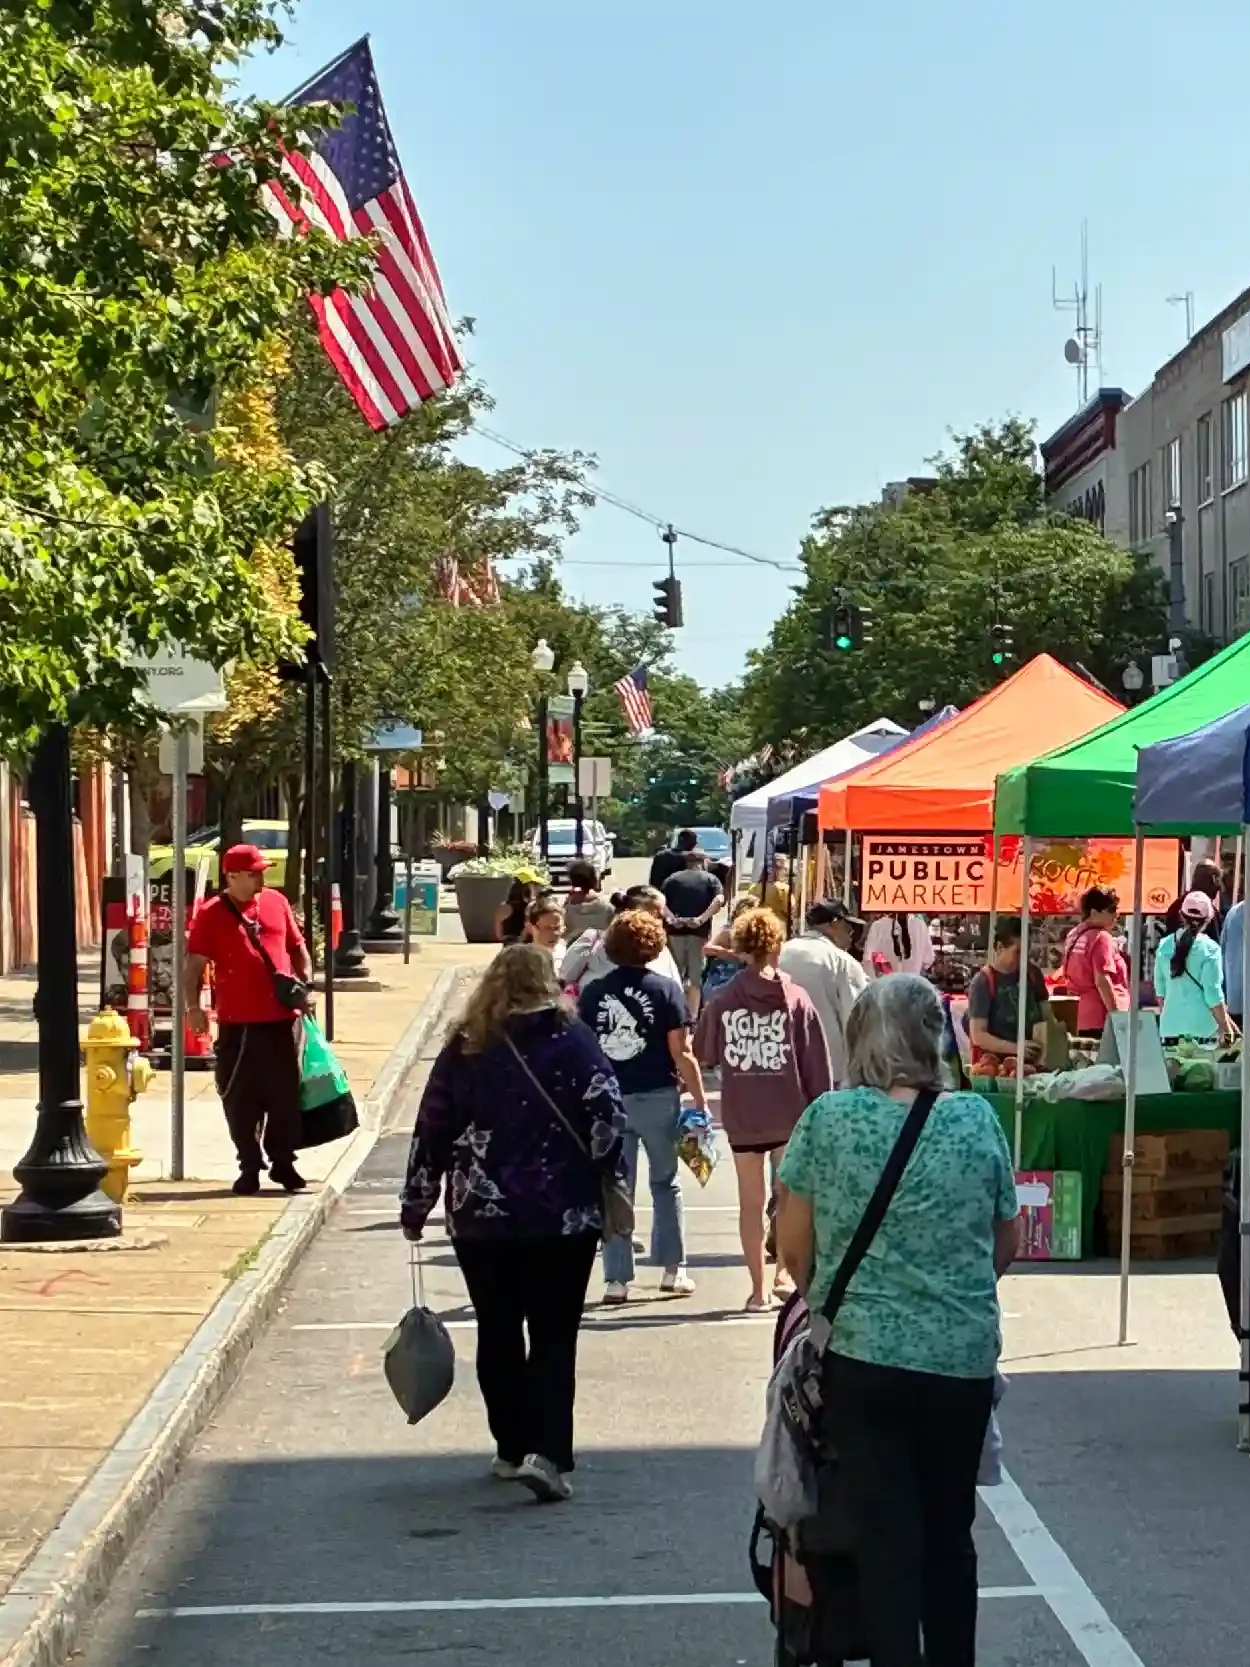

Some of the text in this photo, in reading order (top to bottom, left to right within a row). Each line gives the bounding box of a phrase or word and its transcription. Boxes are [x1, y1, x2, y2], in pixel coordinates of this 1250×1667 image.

[876, 845, 981, 855] JAMESTOWN
[868, 860, 984, 881] PUBLIC
[866, 884, 985, 905] MARKET
